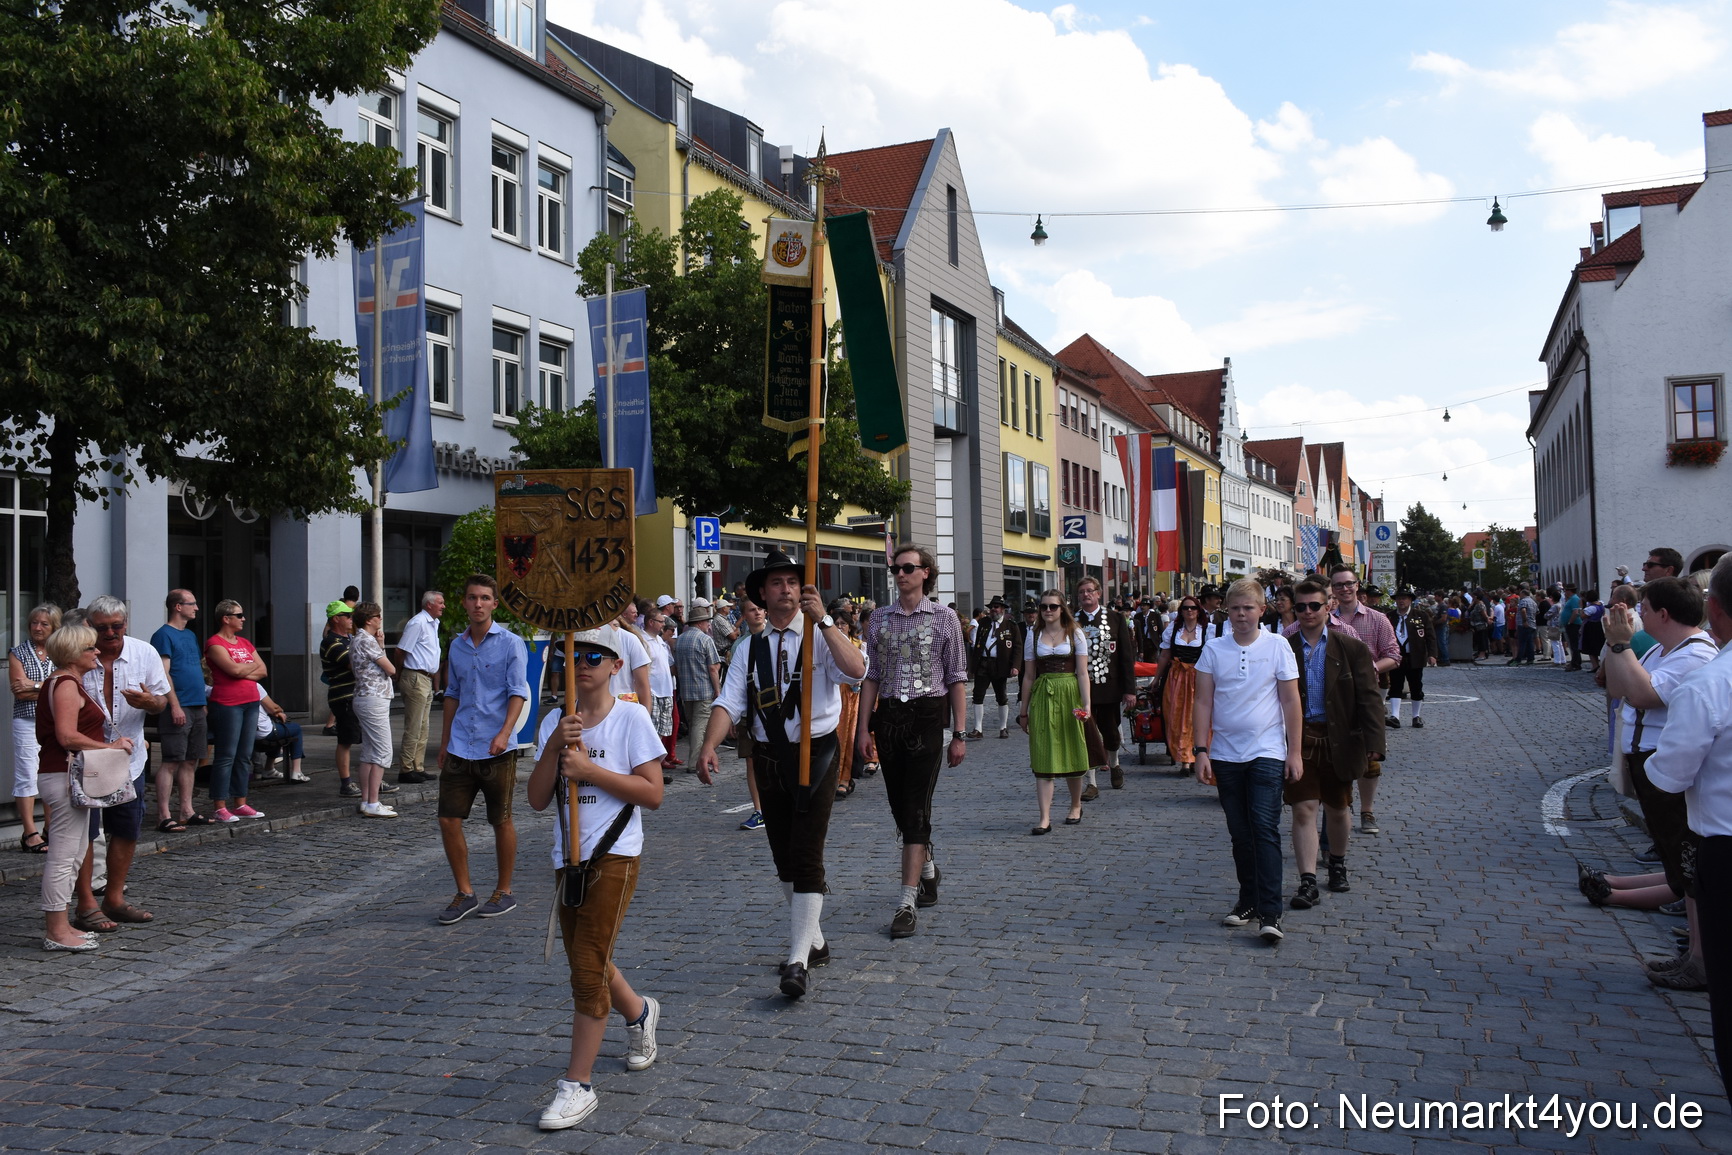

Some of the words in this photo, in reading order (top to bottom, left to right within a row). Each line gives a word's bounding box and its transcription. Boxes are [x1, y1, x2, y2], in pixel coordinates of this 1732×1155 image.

[777, 300, 807, 315] Paten
[777, 351, 804, 365] Dank
[700, 521, 715, 547] P
[567, 537, 626, 574] 1433
